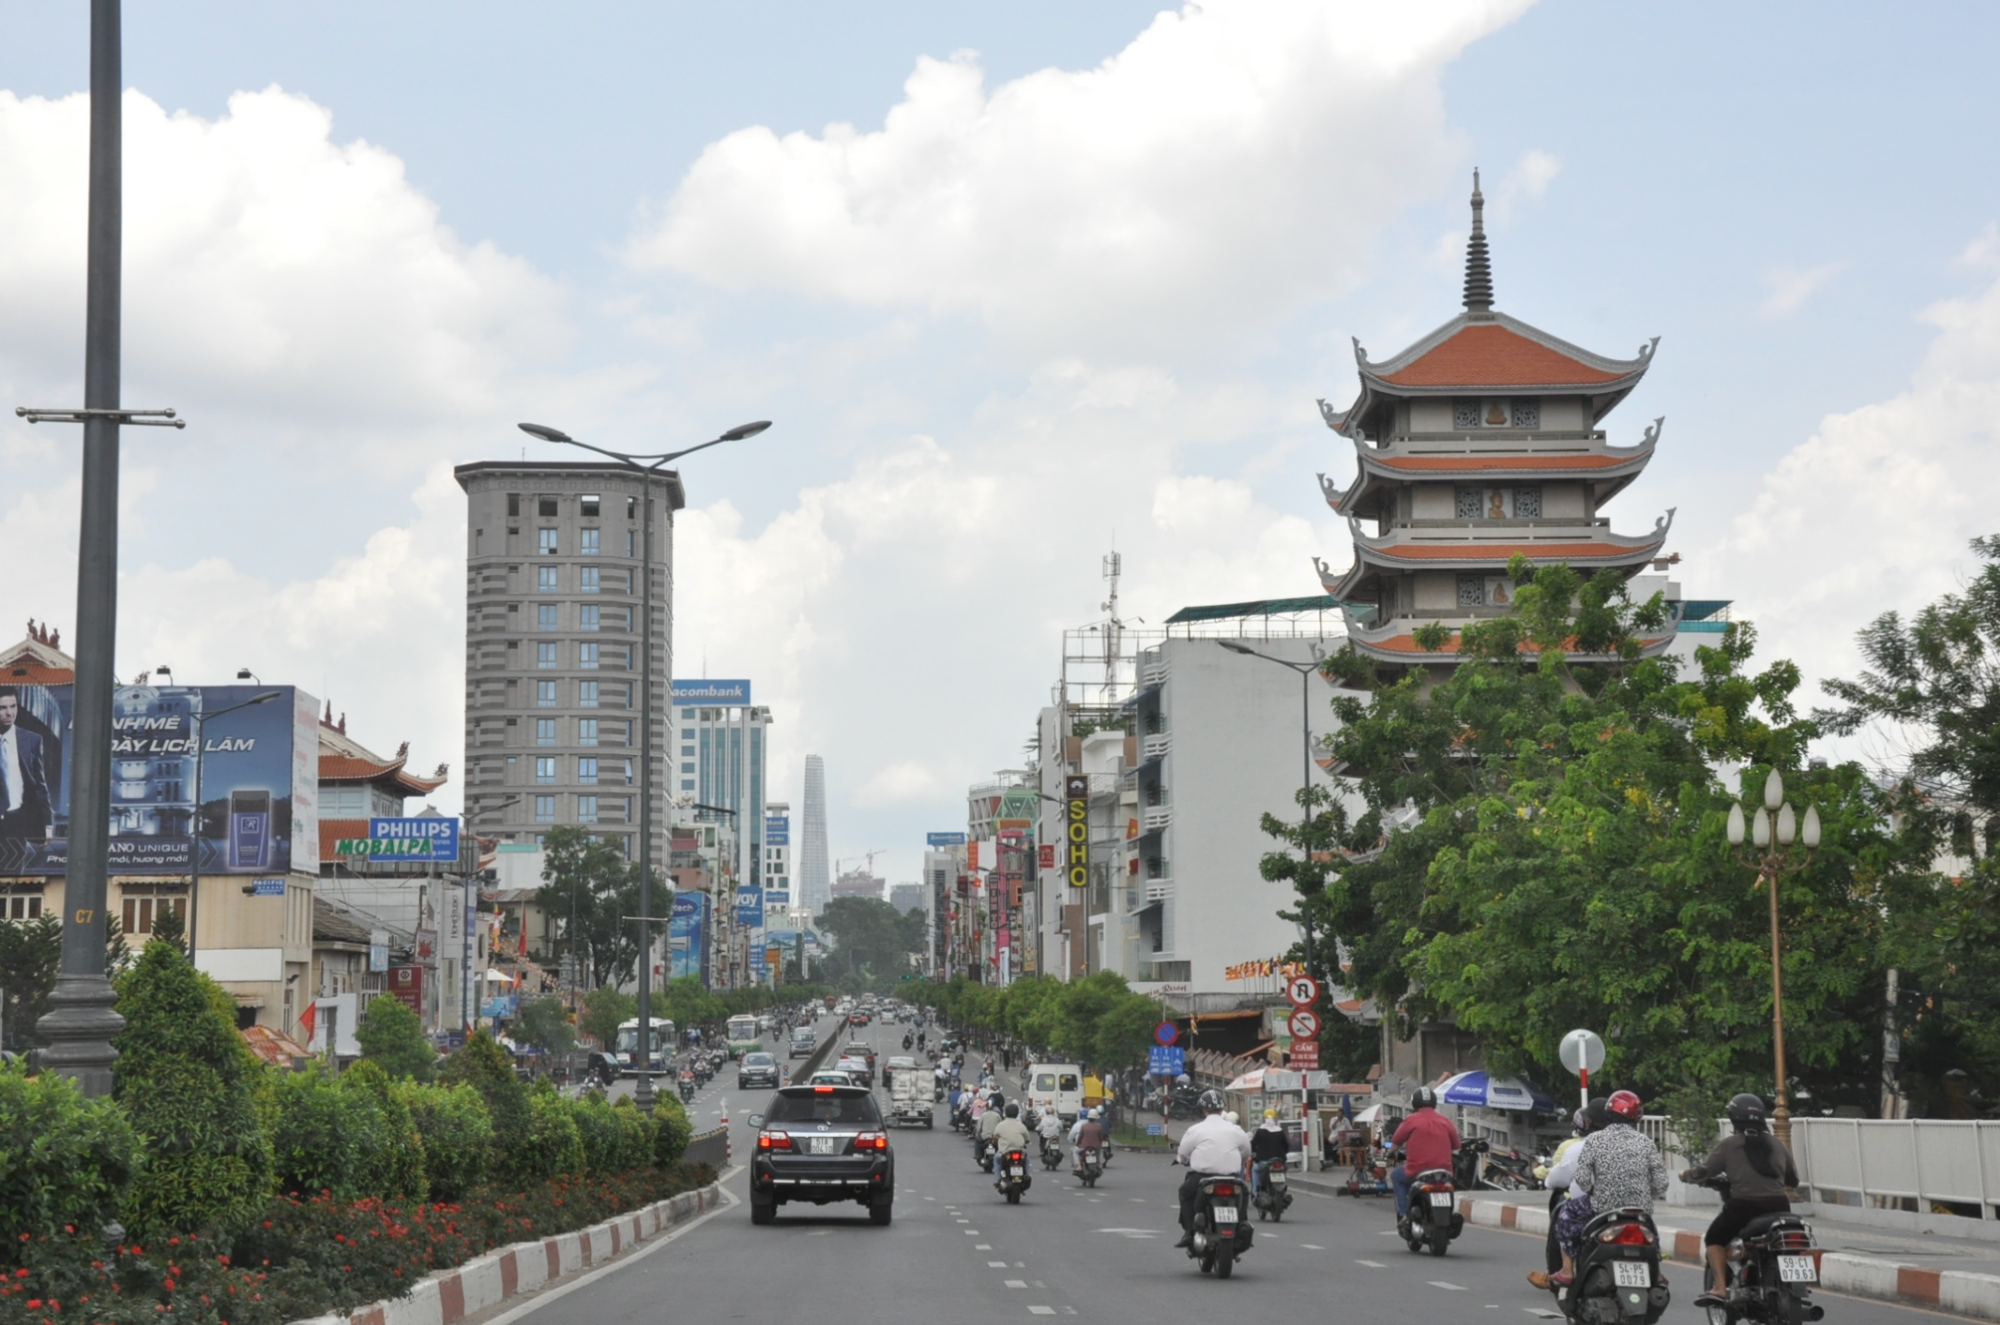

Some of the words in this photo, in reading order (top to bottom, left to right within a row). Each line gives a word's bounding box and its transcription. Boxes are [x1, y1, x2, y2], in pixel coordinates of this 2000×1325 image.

[150, 738, 200, 756] LỊCH
[204, 736, 255, 751] LÃM
[377, 822, 451, 837] PHILIPS
[108, 843, 135, 853] ANO
[138, 844, 189, 853] UNIQUE
[336, 838, 432, 855] MOBALPA
[1069, 800, 1087, 887] SOHO
[673, 904, 694, 913] tech
[75, 909, 94, 924] C7
[1619, 1274, 1645, 1285] 0079
[1782, 1268, 1815, 1280] 079.63
